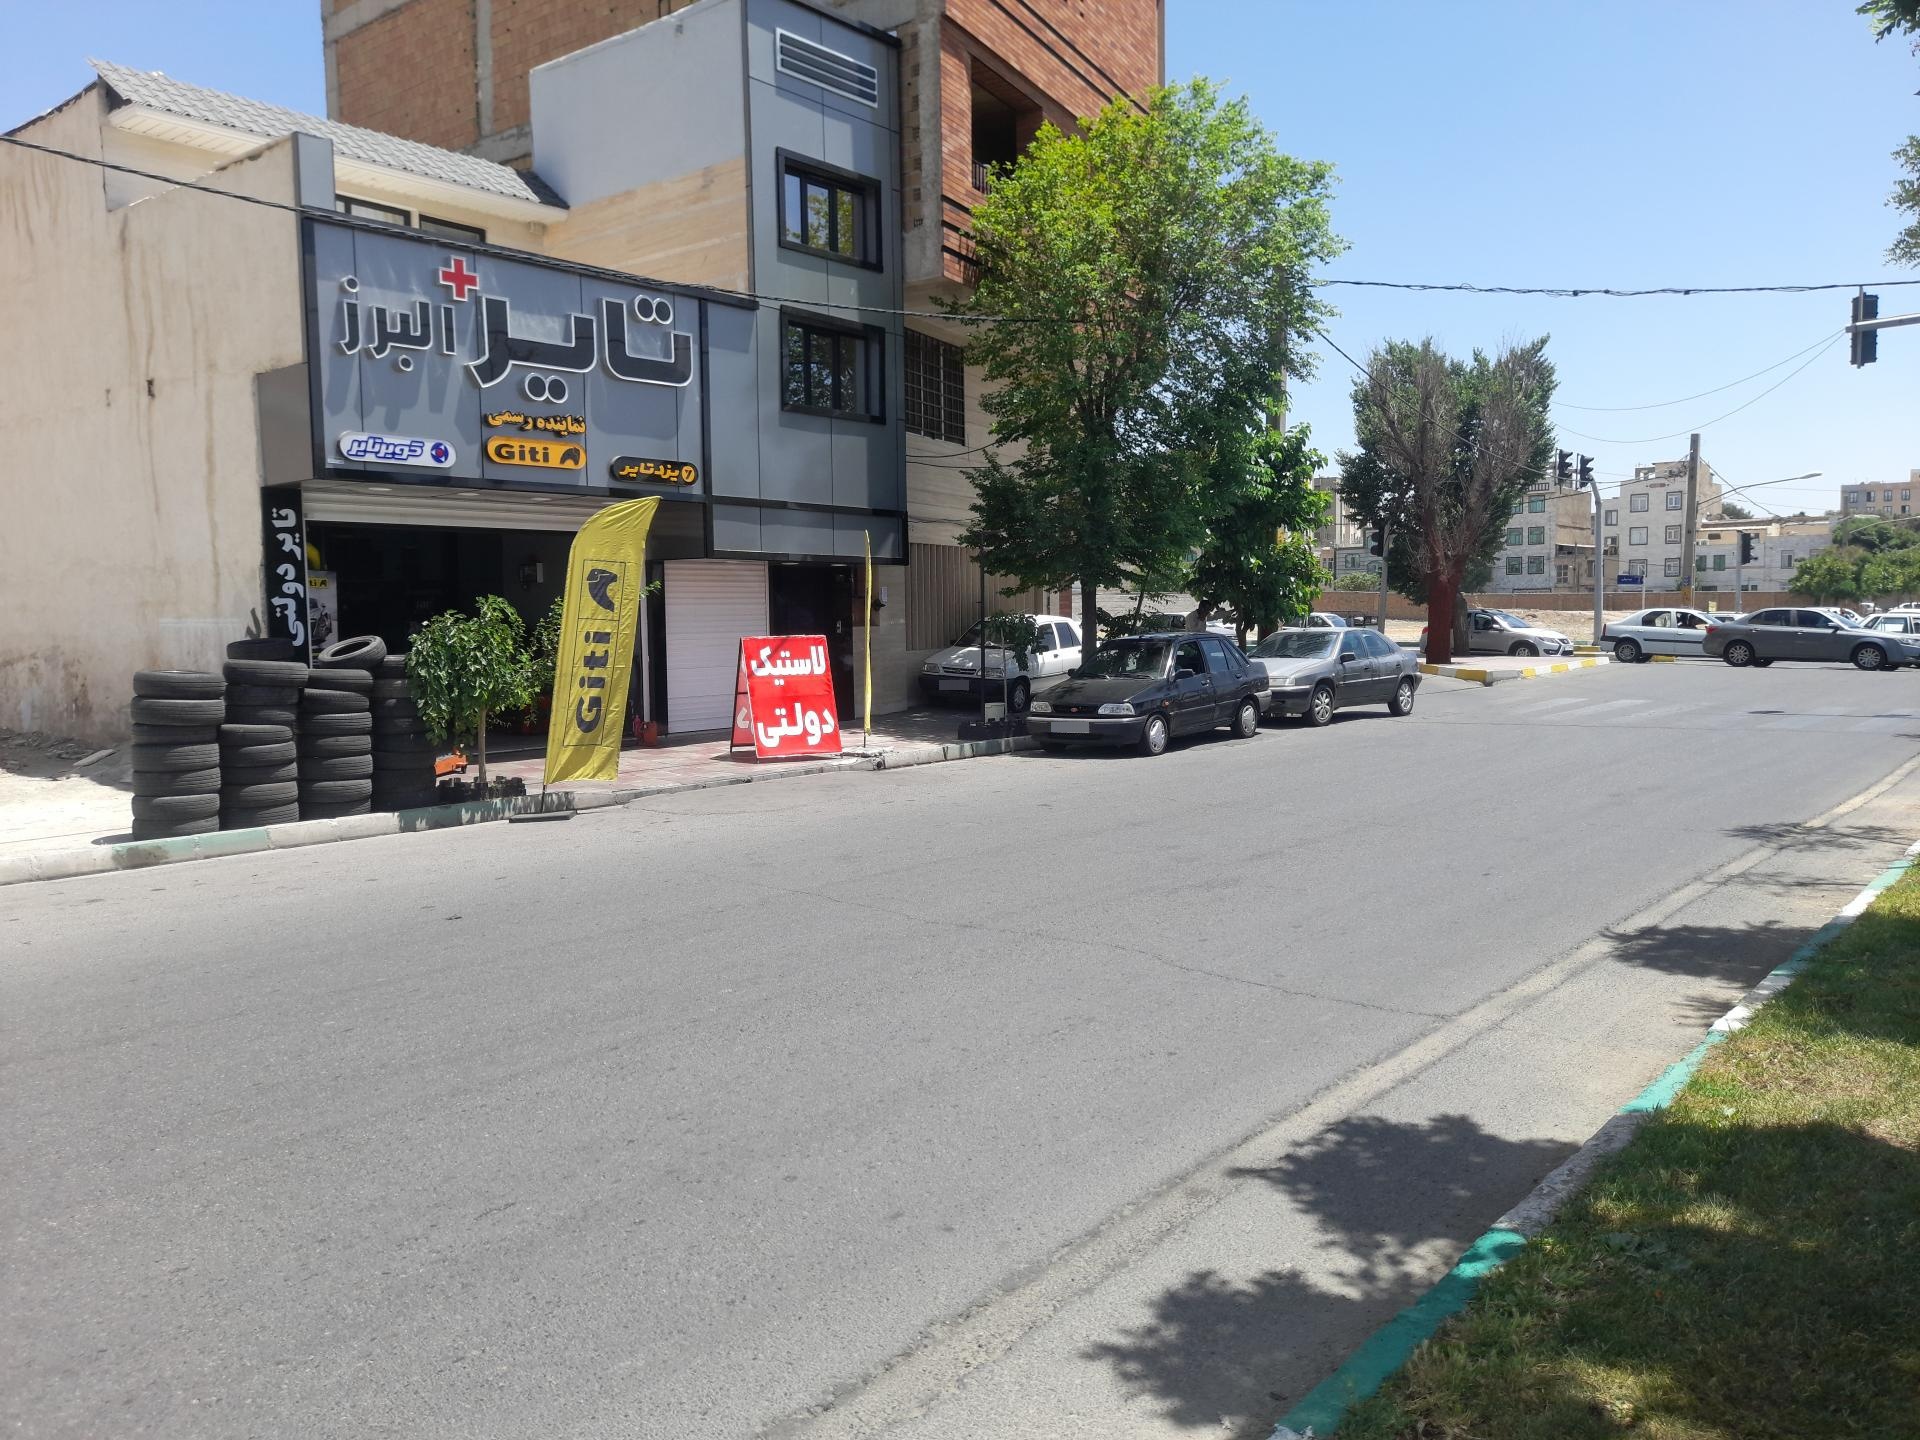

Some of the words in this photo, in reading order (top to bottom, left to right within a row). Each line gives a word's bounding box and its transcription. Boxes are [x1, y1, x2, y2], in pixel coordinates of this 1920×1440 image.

[338, 275, 457, 372] البرز
[465, 294, 693, 404] تایر
[486, 410, 534, 431] رسمی
[536, 414, 586, 436] نماینده
[494, 443, 550, 463] Giti
[271, 507, 302, 561] تایر
[271, 563, 305, 647] دولتی
[576, 631, 611, 734] Giti
[751, 645, 827, 686] لاستیک
[757, 702, 835, 748] دولتی
